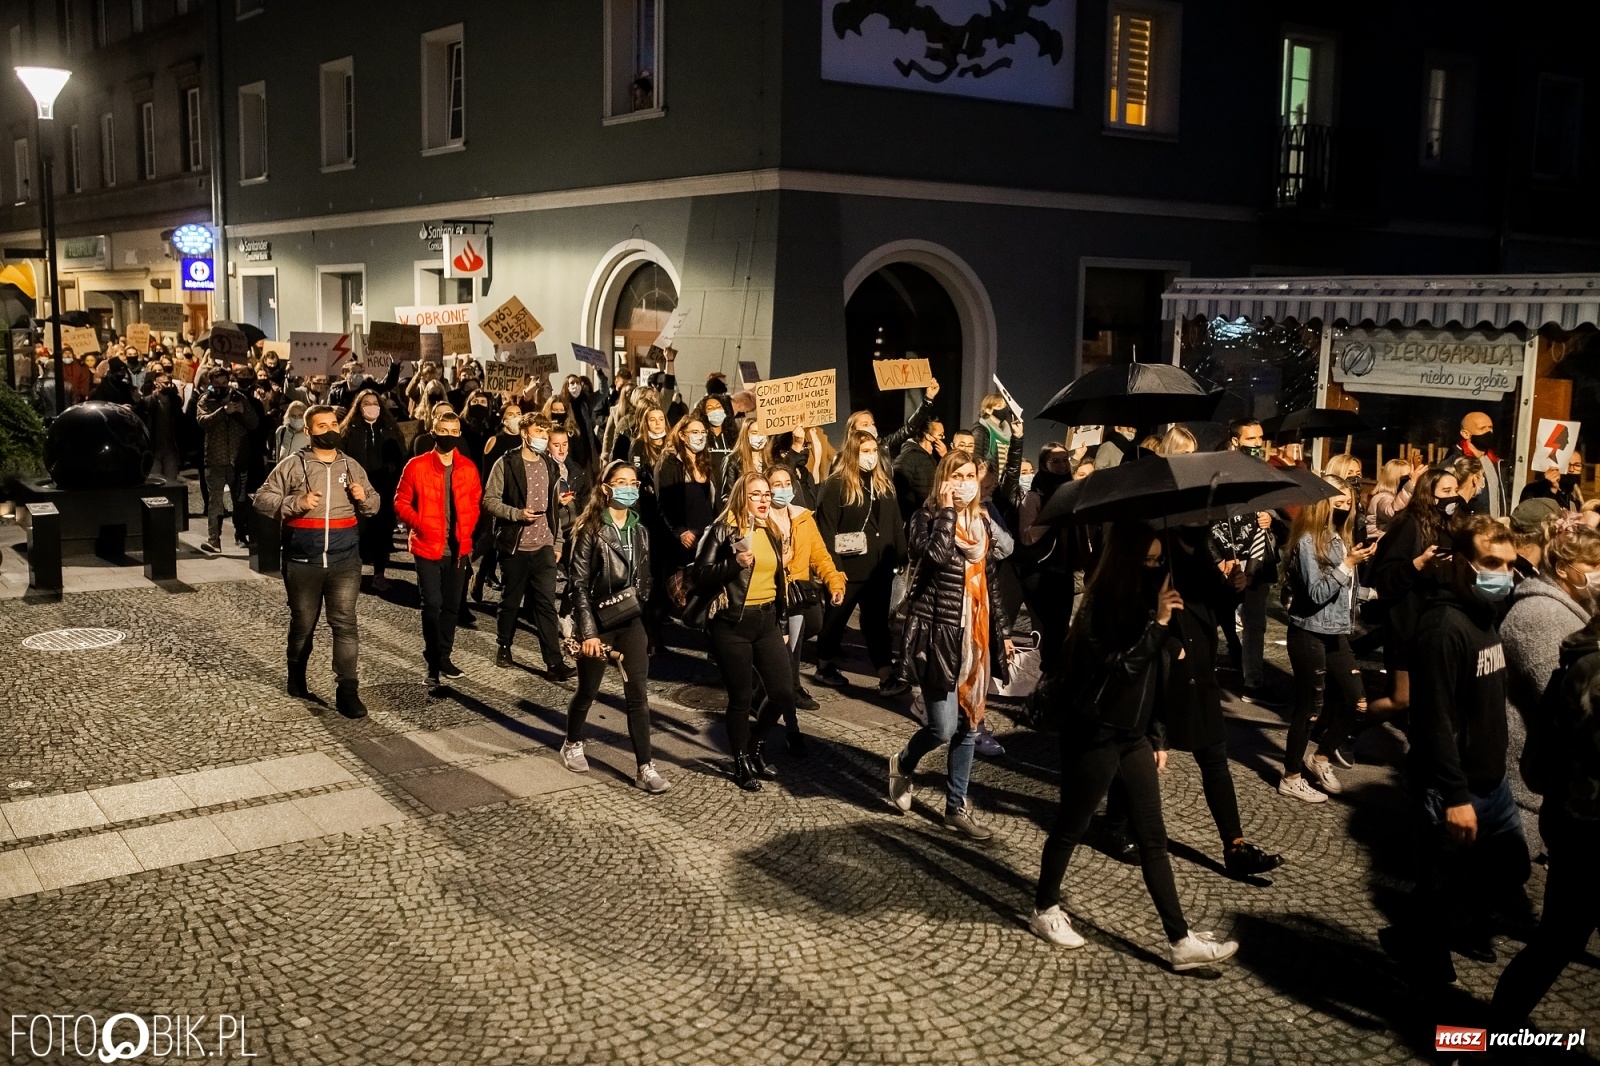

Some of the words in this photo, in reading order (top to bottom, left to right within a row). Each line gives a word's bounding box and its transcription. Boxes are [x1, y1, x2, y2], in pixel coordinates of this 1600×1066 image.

[428, 225, 464, 239] Santaner
[245, 240, 268, 251] Santander
[185, 280, 214, 289] Monetia
[399, 314, 409, 325] W
[416, 308, 470, 326] OBRONIE
[484, 306, 513, 332] TWÓJ
[495, 322, 514, 340] BÓL
[512, 307, 528, 324] JEST
[501, 320, 528, 344] EPSZY
[1383, 341, 1513, 366] PIEROGARNIA
[487, 377, 516, 392] KOBIET
[1420, 366, 1454, 386] niebo
[1458, 374, 1471, 386] w
[1473, 368, 1510, 395] gębie
[757, 383, 781, 397] GDYBY
[784, 381, 794, 393] TO
[760, 393, 804, 408] ZACHODZILI
[767, 408, 777, 416] TO
